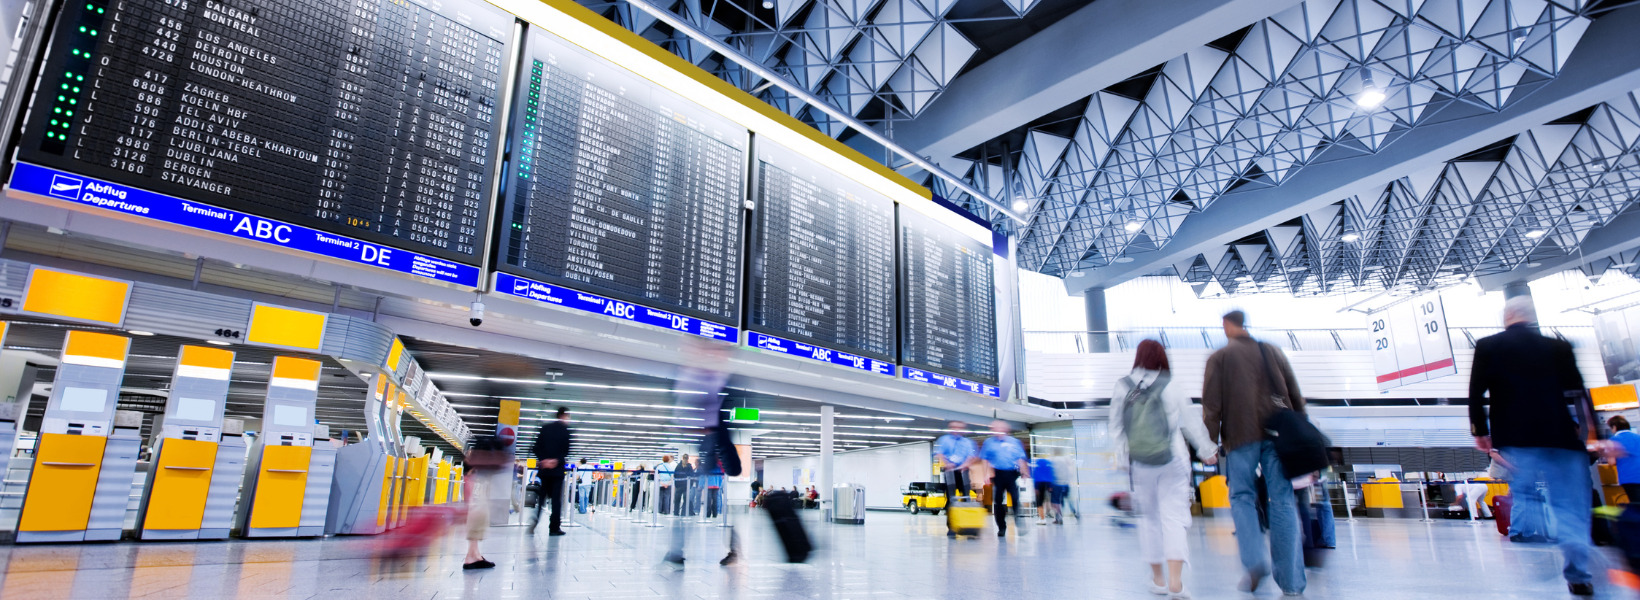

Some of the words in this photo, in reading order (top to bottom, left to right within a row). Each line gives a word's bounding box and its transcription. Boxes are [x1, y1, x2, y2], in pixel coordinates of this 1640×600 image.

[203, 10, 259, 37] MONTREAL
[205, 0, 256, 24] CALGARY
[114, 12, 120, 22] L
[156, 27, 180, 41] 442
[194, 40, 246, 64] DETROIT
[117, 1, 124, 11] L
[159, 17, 182, 31] 456
[197, 30, 220, 44] LOS
[227, 41, 276, 64] ANGELES
[110, 22, 117, 33] L
[153, 38, 176, 52] 440
[192, 50, 244, 75] HOUSTON
[100, 56, 110, 66] O
[144, 70, 168, 84] 417
[184, 82, 229, 103] ZAGREB
[107, 34, 114, 44] L
[142, 46, 173, 62] 4726
[190, 62, 296, 102] LONDON-HEATHROW
[94, 78, 101, 89] L
[137, 92, 161, 106] 686
[179, 104, 199, 118] TEL
[208, 113, 239, 128] AVIV
[97, 67, 104, 77] L
[132, 78, 164, 95] 6808
[181, 93, 220, 111] KOELN
[226, 107, 248, 120] HBF
[87, 102, 94, 112] L
[133, 114, 156, 128] 176
[172, 126, 260, 158] BERLIN-TEGEL
[90, 90, 97, 100] L
[134, 103, 159, 117] 590
[174, 115, 214, 133] ADDIS
[221, 129, 318, 162] ABEBA-KHARTOUM
[80, 125, 87, 135] L
[116, 135, 150, 151] 4980
[166, 148, 214, 167] DUBLIN
[84, 114, 92, 123] J
[130, 126, 153, 139] 117
[170, 137, 238, 162] LJUBLJANA
[77, 137, 83, 147] L
[113, 146, 146, 162] 3126
[163, 159, 211, 178] BERGEN
[73, 149, 80, 159] L
[110, 158, 144, 174] 3160
[161, 171, 231, 195] STAVANGER
[85, 182, 127, 200] Abflug
[82, 193, 150, 214] Departures
[181, 202, 227, 220] Terminal
[233, 216, 292, 243] ABC
[316, 233, 352, 248] Terminal
[361, 244, 392, 266] DE
[529, 290, 563, 304] Departures
[530, 282, 551, 294] Abflug
[604, 300, 635, 319] ABC
[1420, 301, 1434, 315] 10
[215, 328, 240, 339] 464
[672, 315, 689, 331] DE
[1372, 319, 1385, 332] 20
[1424, 320, 1438, 334] 10
[812, 347, 831, 362] ABC
[1375, 337, 1388, 350] 20
[854, 356, 865, 369] DE
